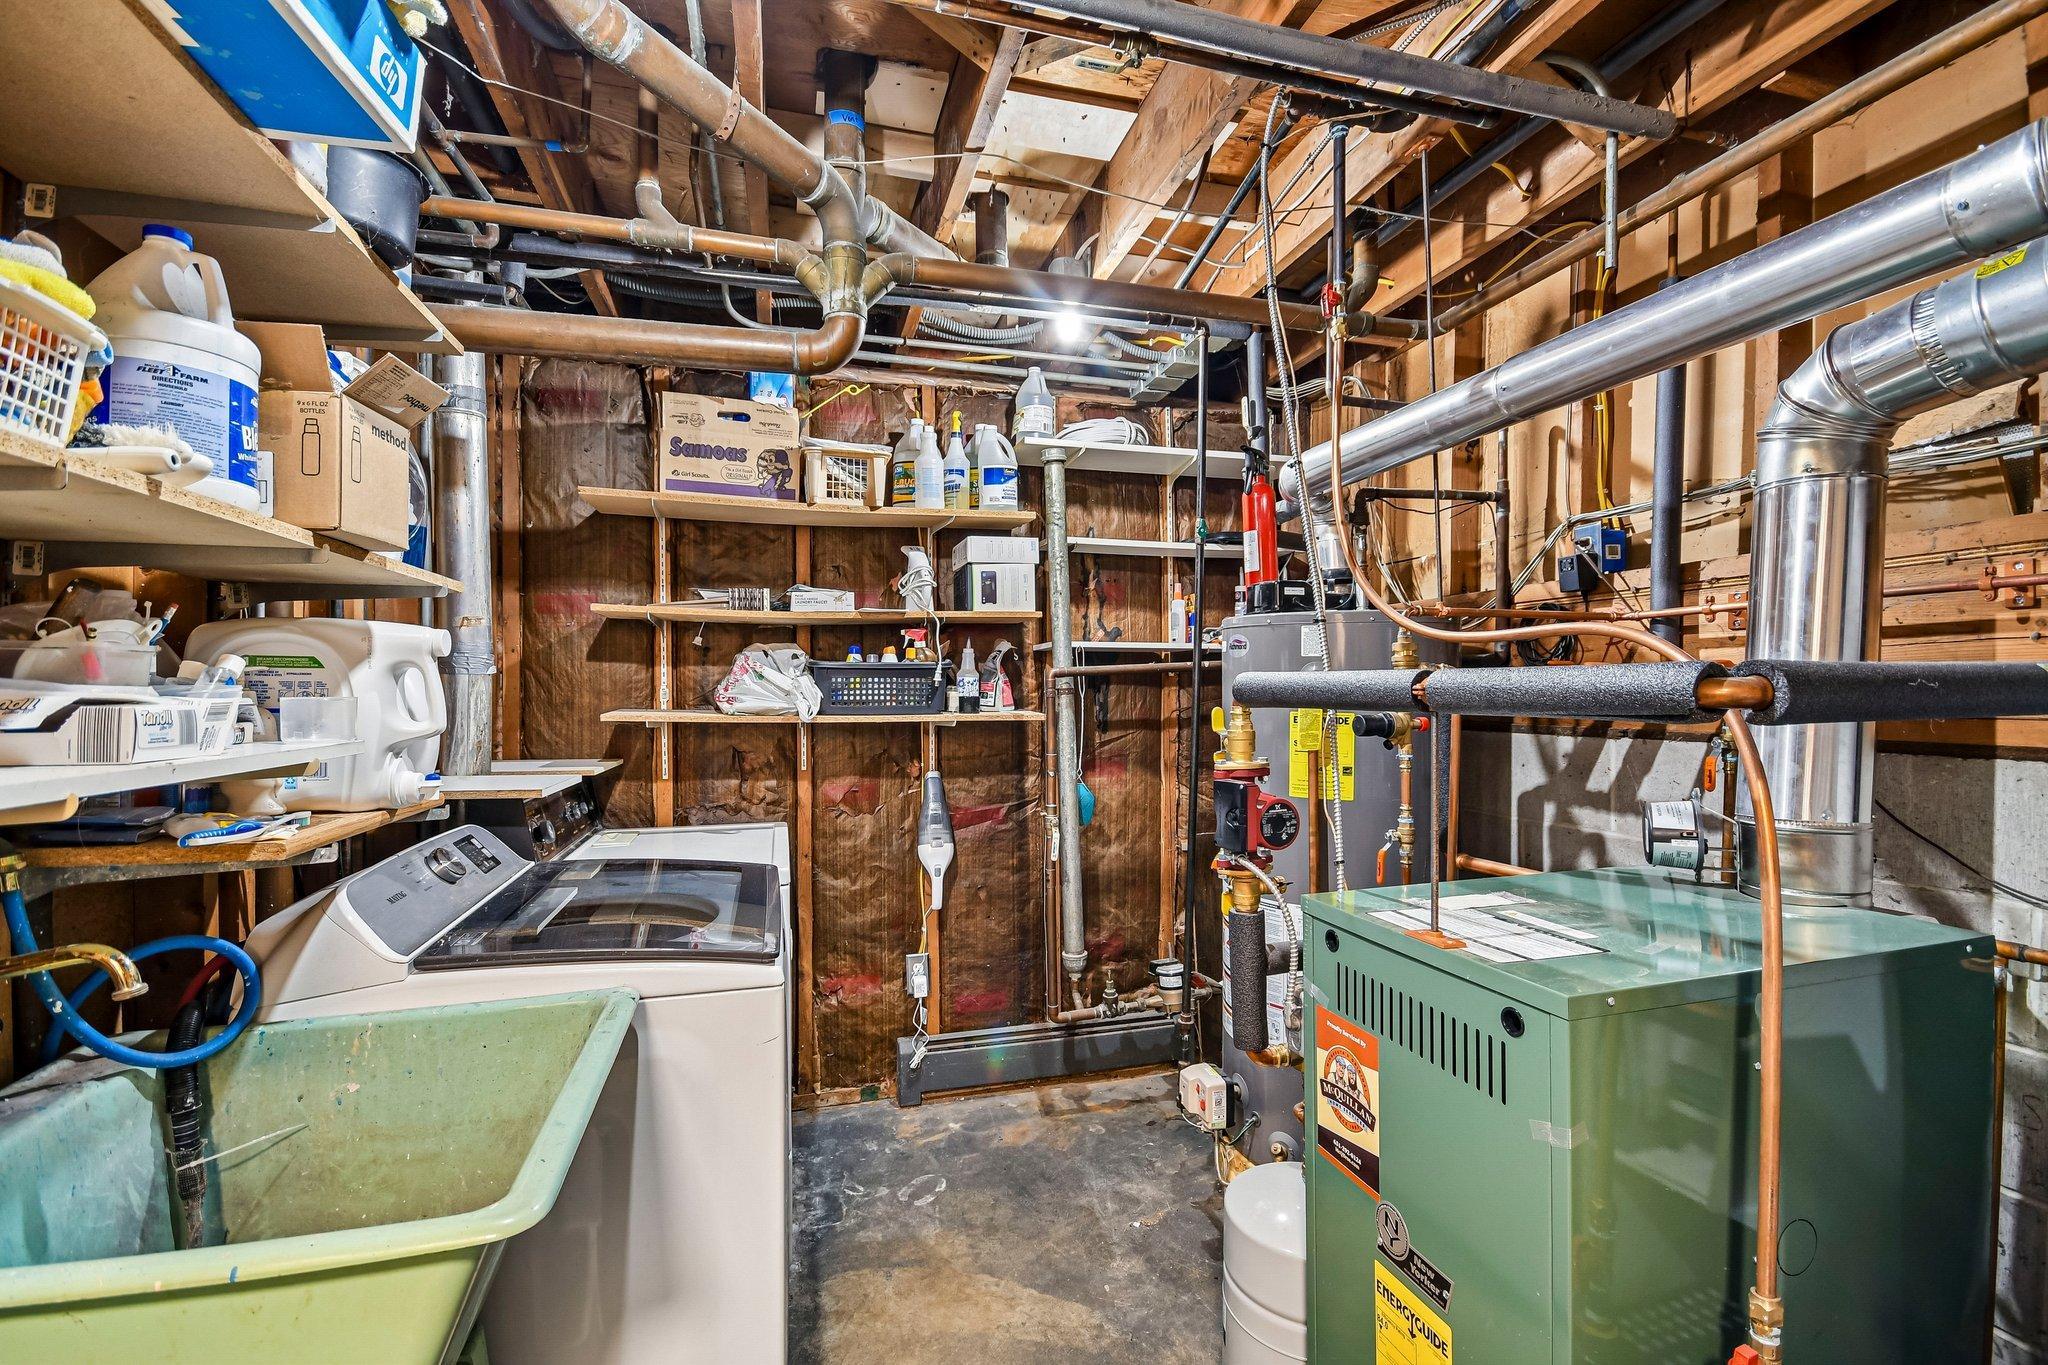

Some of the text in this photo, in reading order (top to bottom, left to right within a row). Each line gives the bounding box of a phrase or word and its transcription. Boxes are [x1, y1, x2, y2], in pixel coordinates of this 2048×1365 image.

[381, 55, 398, 96] hp
[136, 366, 209, 384] FLEET FARM
[152, 375, 194, 387] DIRECTIONS
[157, 382, 188, 392] HOUSEHOLD
[160, 400, 184, 408] LAUNDRY
[371, 423, 406, 451] method
[669, 436, 748, 462] Samoas
[387, 891, 407, 905] MAYTAG
[1326, 1020, 1343, 1034] Proudly
[1322, 1081, 1372, 1124] McQUILLAN
[1410, 1262, 1441, 1295] Yorker
[1413, 1255, 1435, 1280] New
[1376, 1279, 1448, 1359] ENERGYGUIDE
